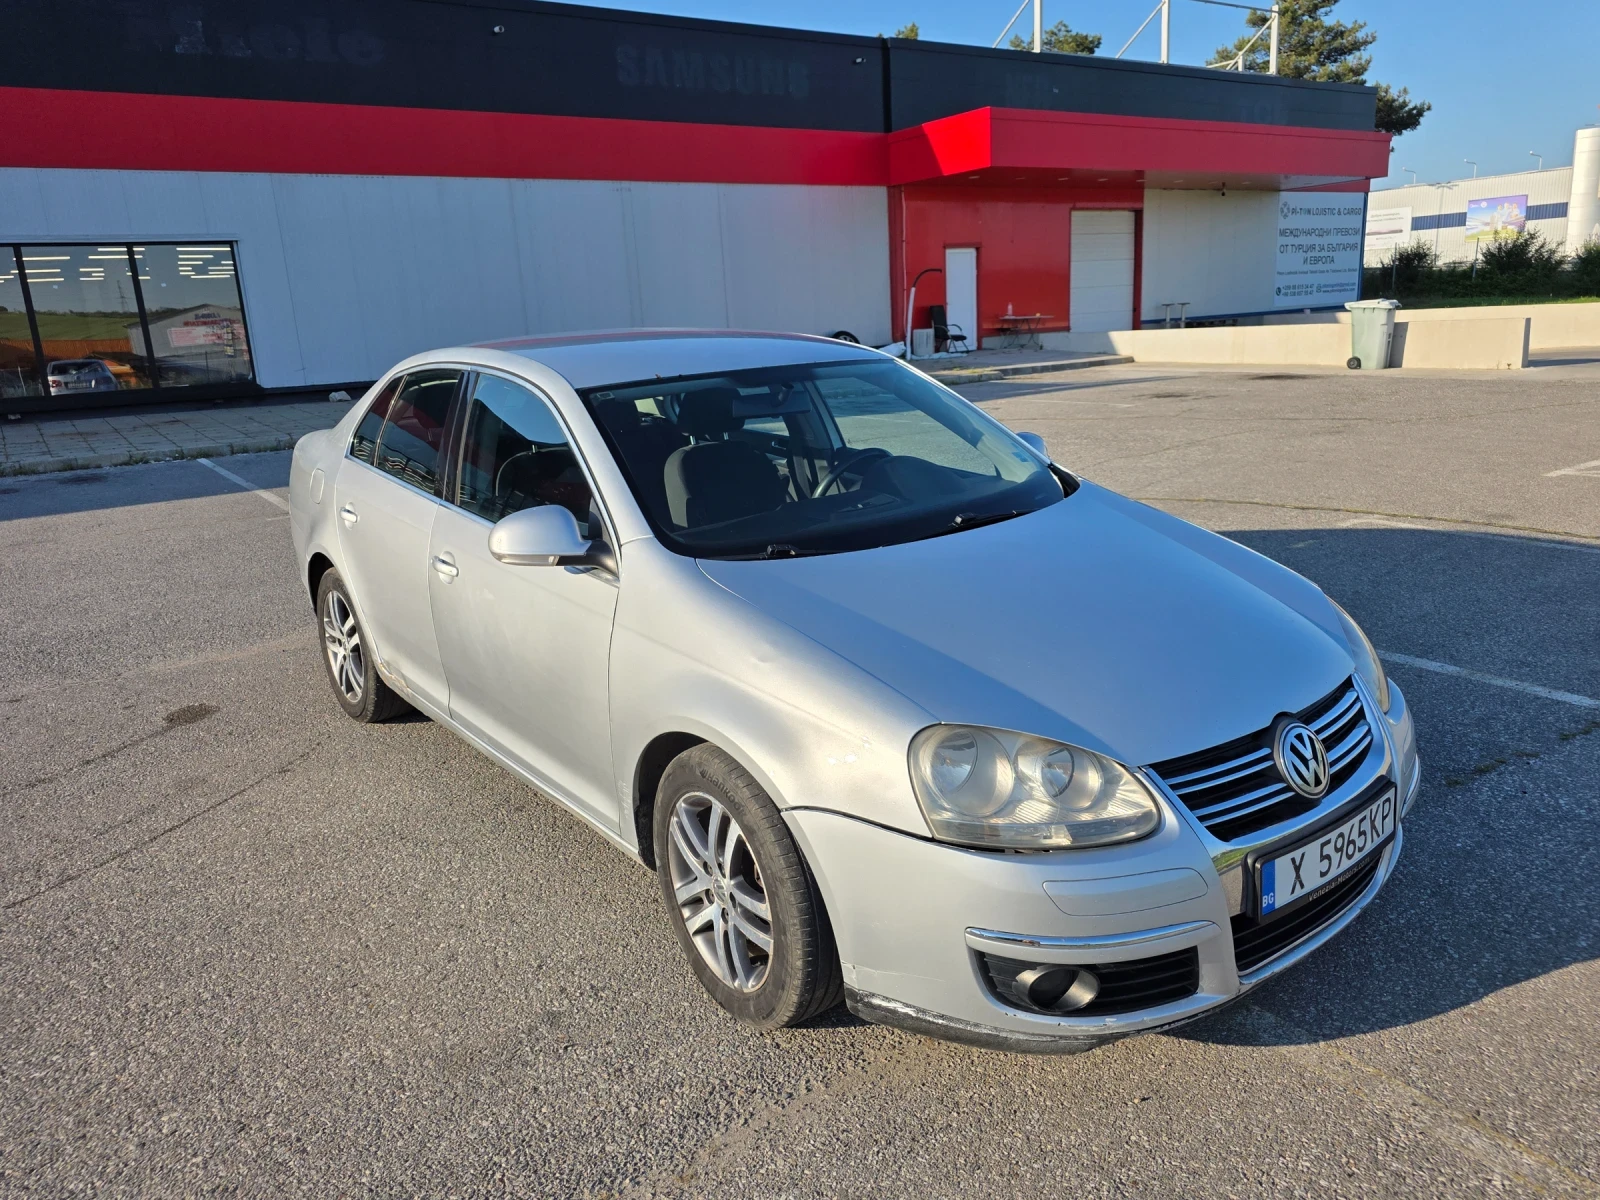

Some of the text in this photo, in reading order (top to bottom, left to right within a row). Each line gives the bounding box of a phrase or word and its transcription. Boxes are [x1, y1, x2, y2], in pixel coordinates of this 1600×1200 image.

[1337, 207, 1342, 216] &
[1343, 207, 1362, 216] CARGO
[1279, 227, 1360, 238] МЕЖДУНАРОДНИ ПРЕВОЗИ
[1279, 242, 1359, 254] ОТ ТУРЦИЯ ЗА БЪЛГАРИЯ
[1303, 255, 1335, 265] И ЕВРОПА
[1289, 851, 1306, 896] X
[1261, 892, 1275, 908] BG
